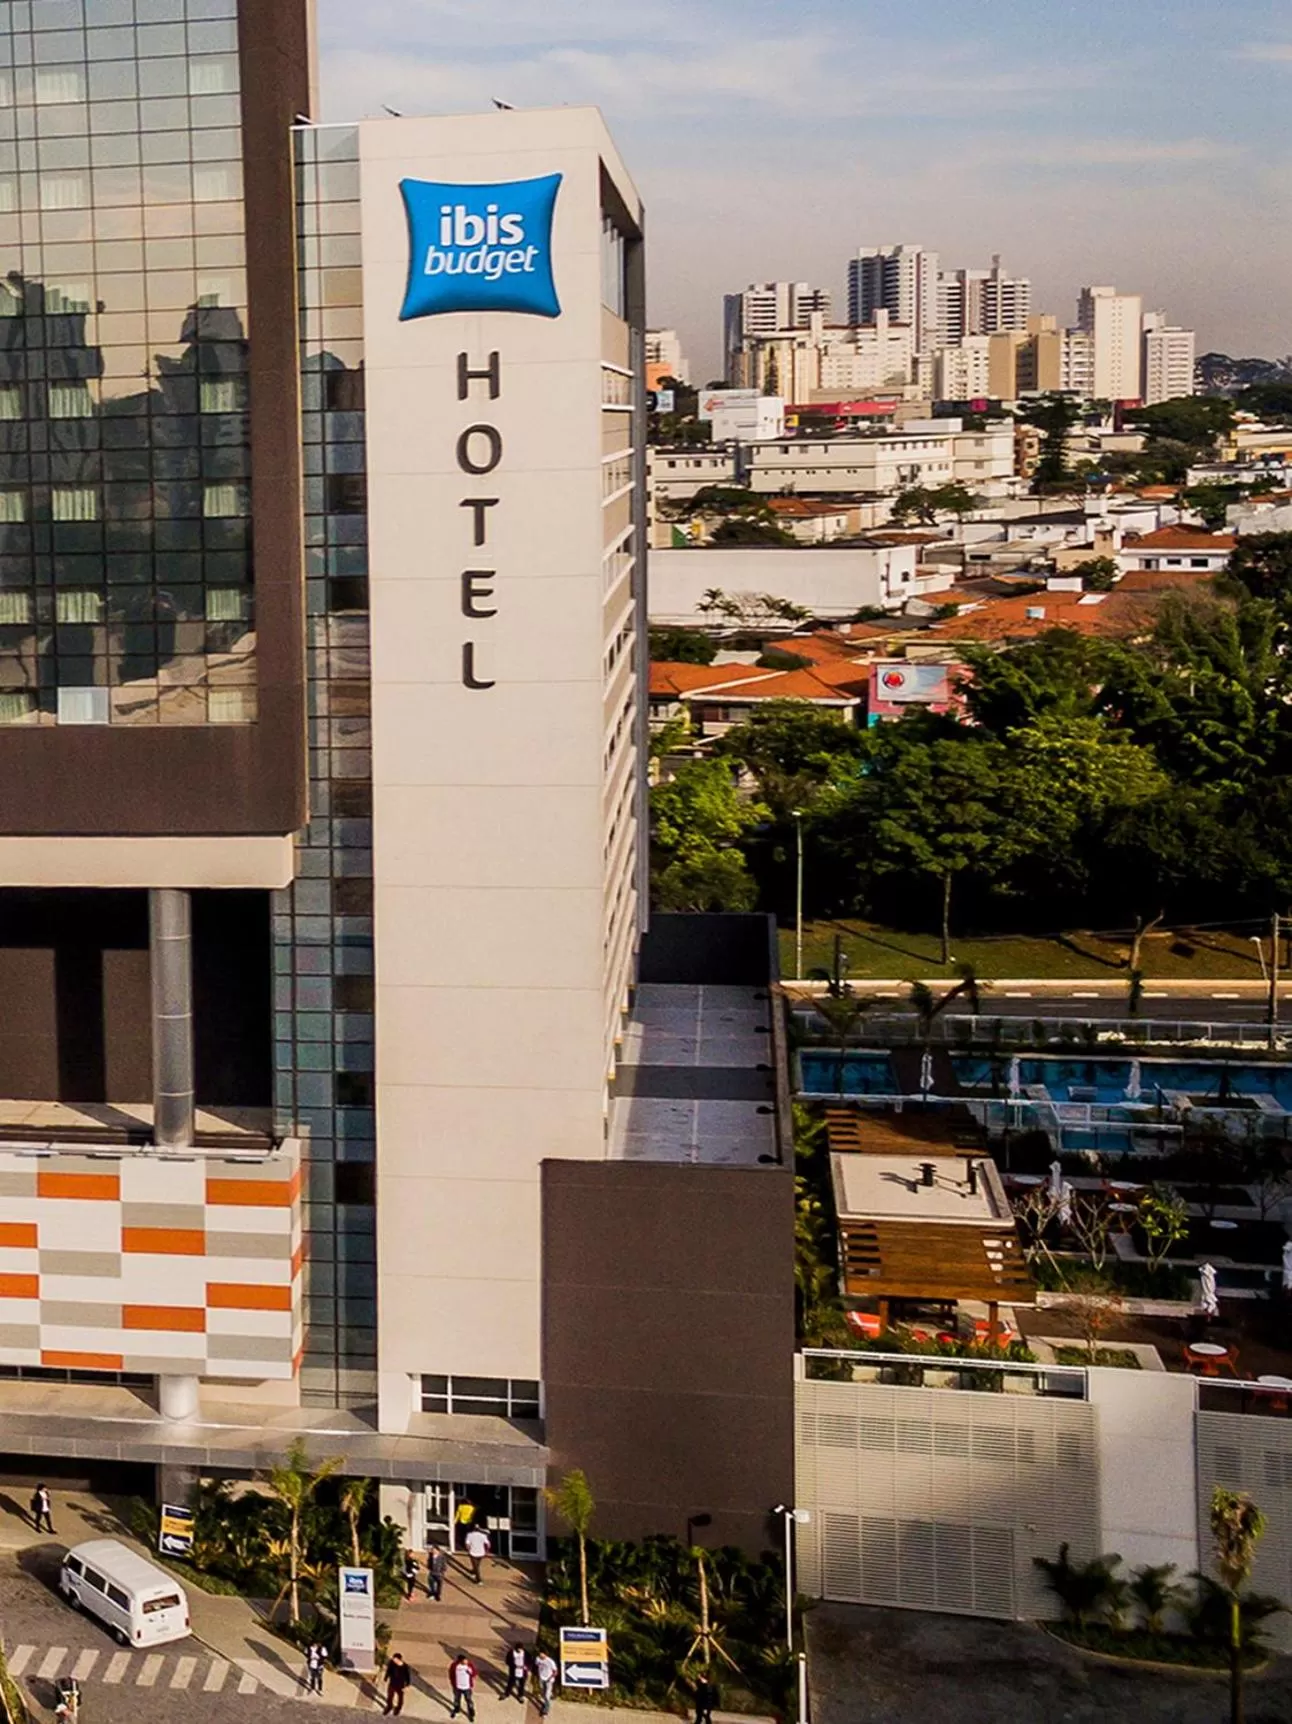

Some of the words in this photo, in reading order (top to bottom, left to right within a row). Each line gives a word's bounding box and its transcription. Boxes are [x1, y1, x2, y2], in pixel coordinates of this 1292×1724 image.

[440, 204, 525, 247] ibis
[424, 245, 540, 281] budget
[456, 350, 503, 690] HOTEL
